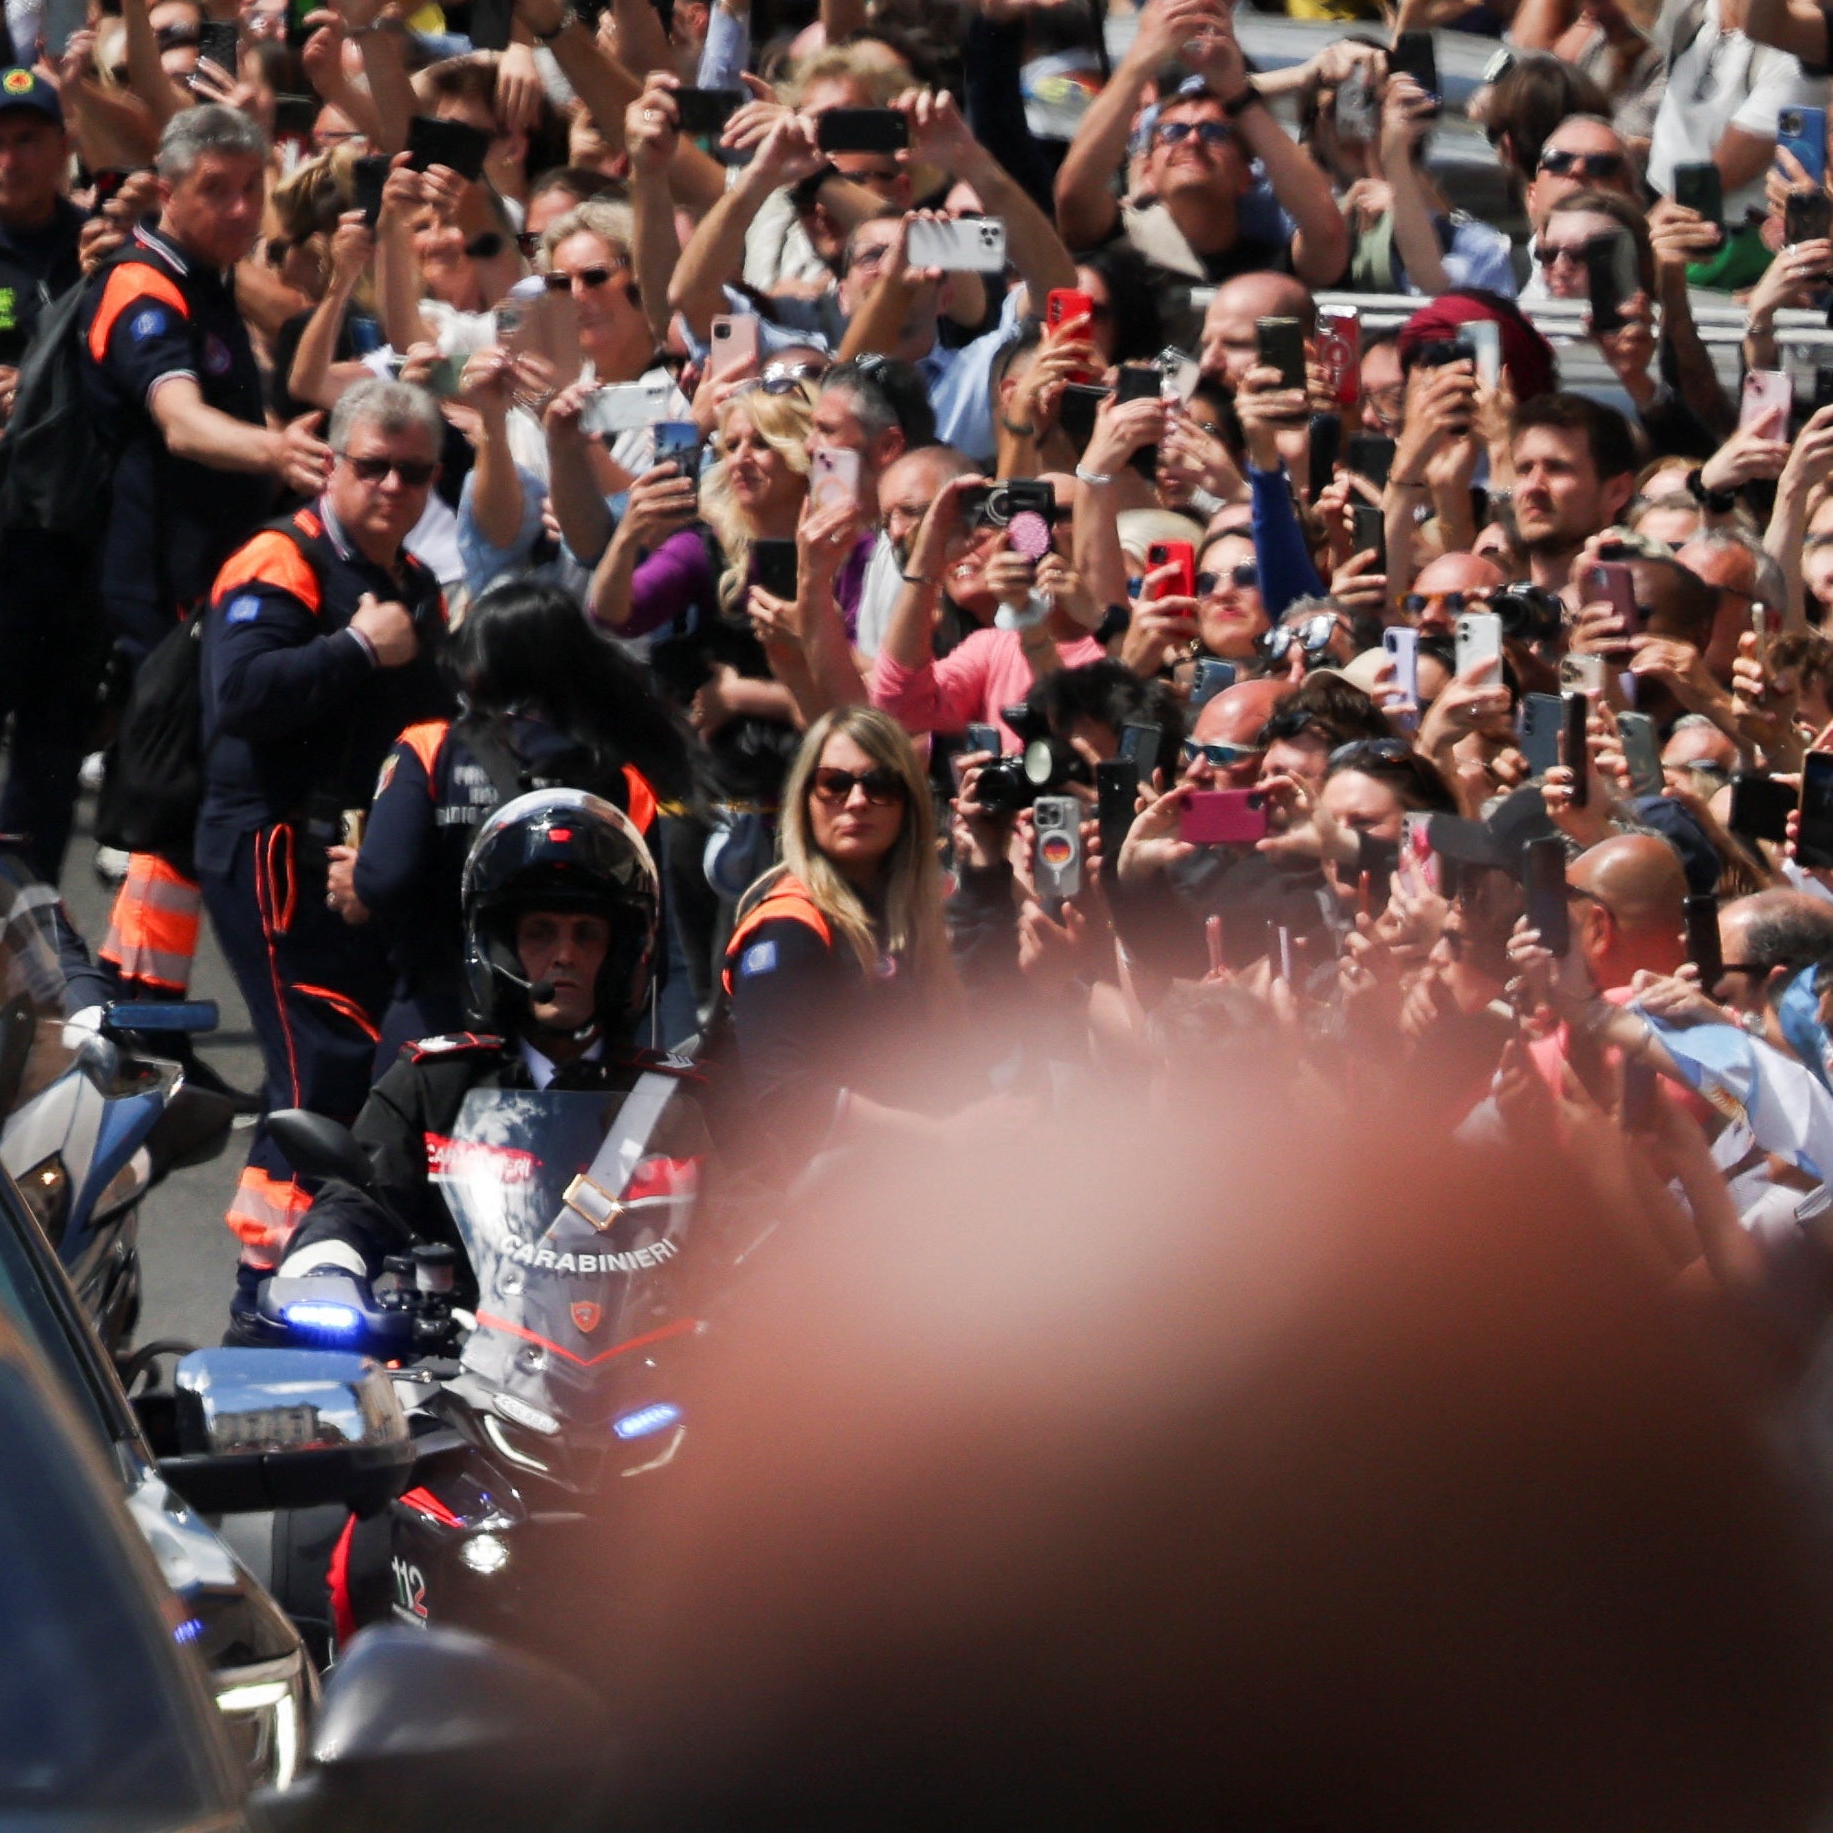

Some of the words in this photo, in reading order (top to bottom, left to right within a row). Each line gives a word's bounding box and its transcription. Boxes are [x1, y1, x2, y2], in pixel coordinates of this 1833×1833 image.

[425, 1143, 531, 1178] CARERI
[499, 1233, 679, 1273] CARABINIERI
[390, 1554, 428, 1619] 112
